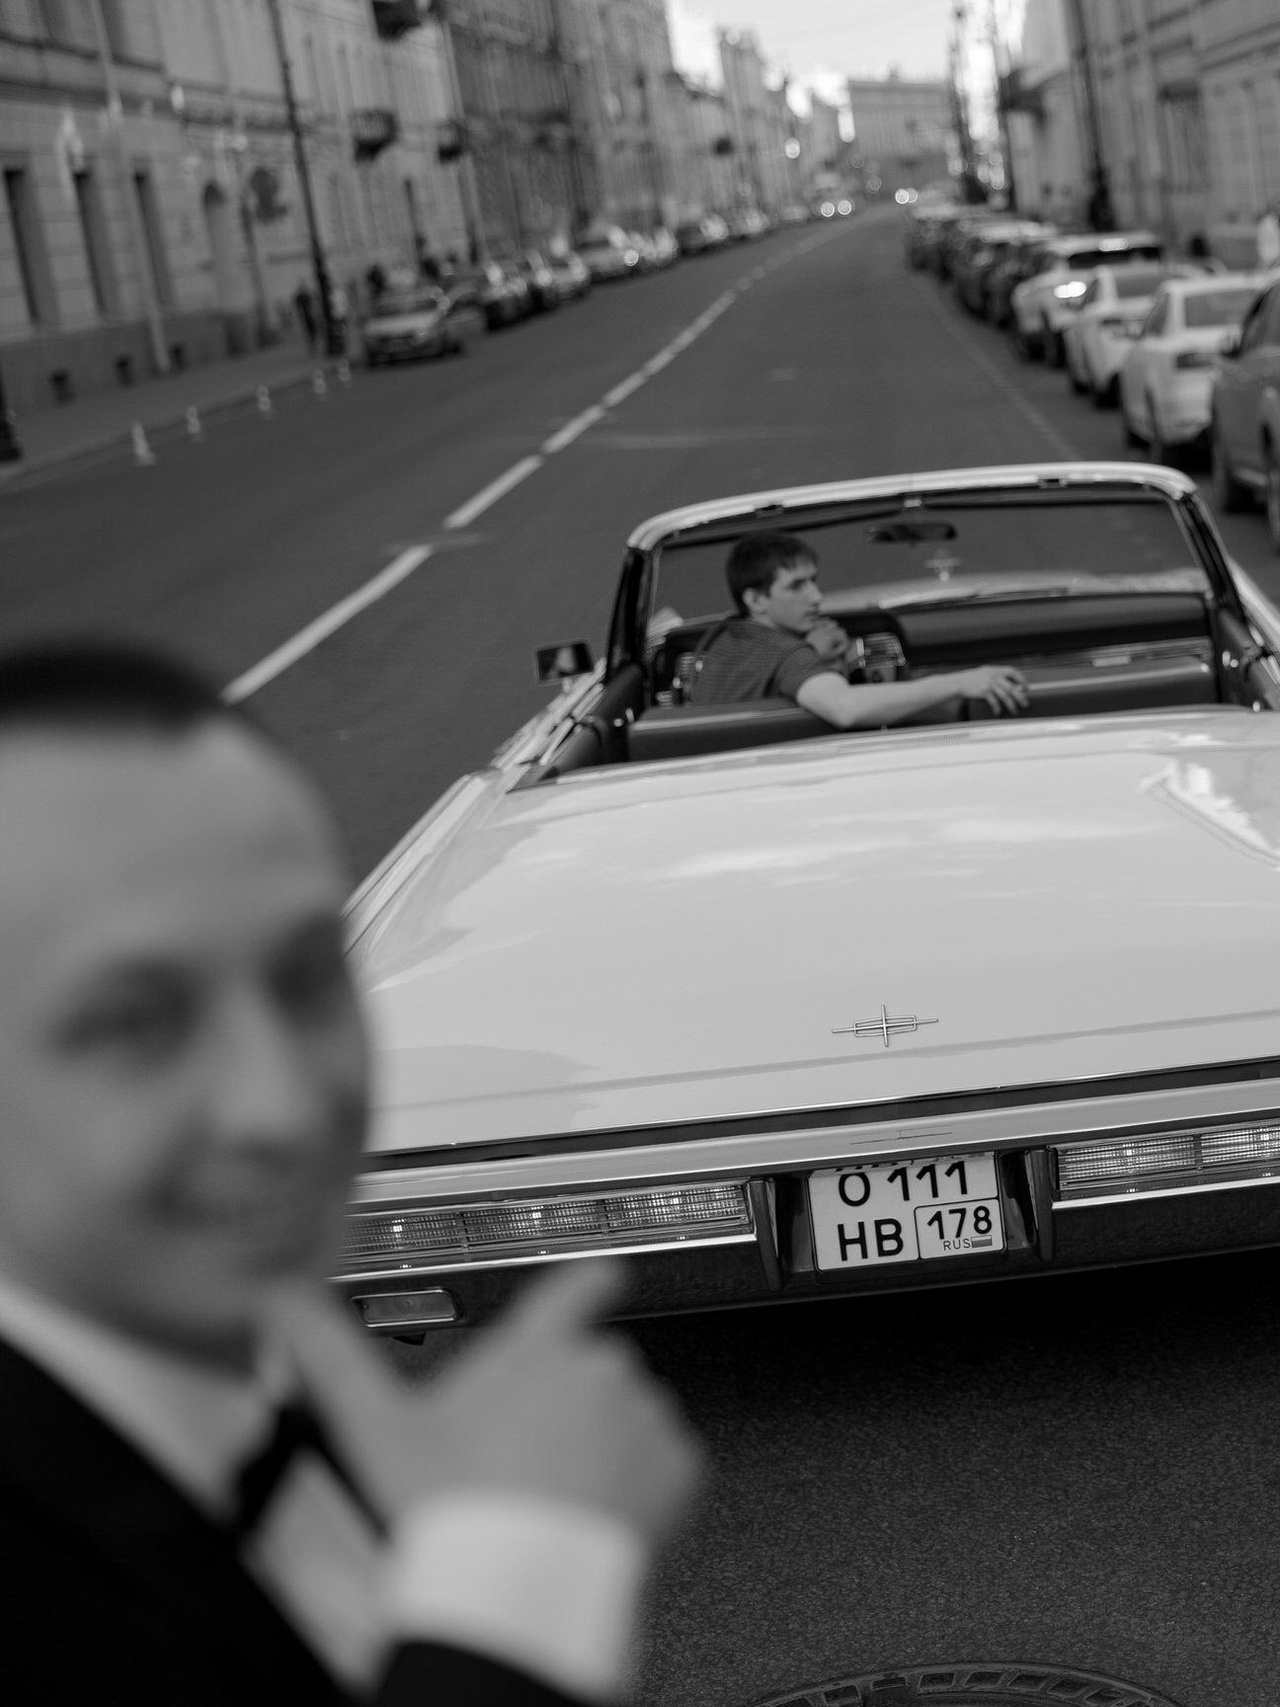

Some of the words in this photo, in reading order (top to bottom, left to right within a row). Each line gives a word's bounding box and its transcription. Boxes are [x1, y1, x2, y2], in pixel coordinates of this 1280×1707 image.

[887, 1160, 968, 1202] 111
[926, 1205, 993, 1240] 178
[943, 1238, 971, 1251] RUS
